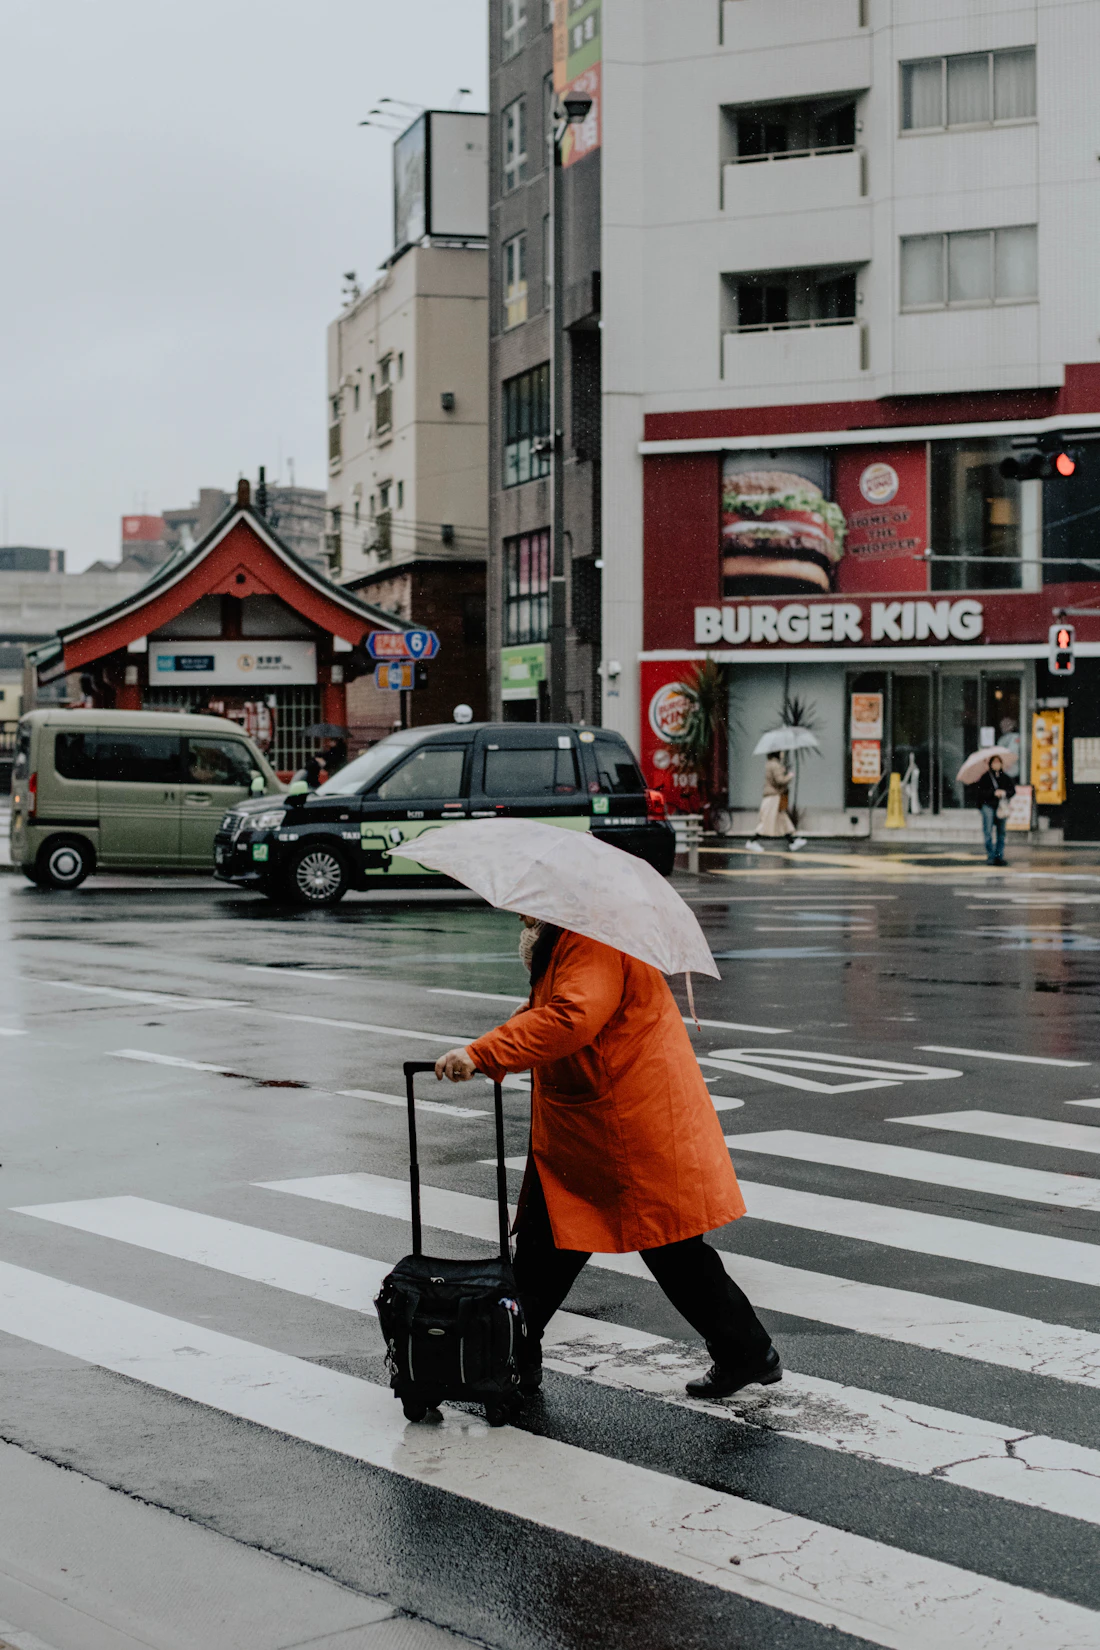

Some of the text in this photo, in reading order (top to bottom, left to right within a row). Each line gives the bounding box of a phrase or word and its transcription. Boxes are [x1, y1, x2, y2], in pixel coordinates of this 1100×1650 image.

[694, 599, 984, 644] BURGER KING
[410, 633, 423, 652] 6
[407, 810, 424, 818] km
[342, 831, 361, 839] TAXI
